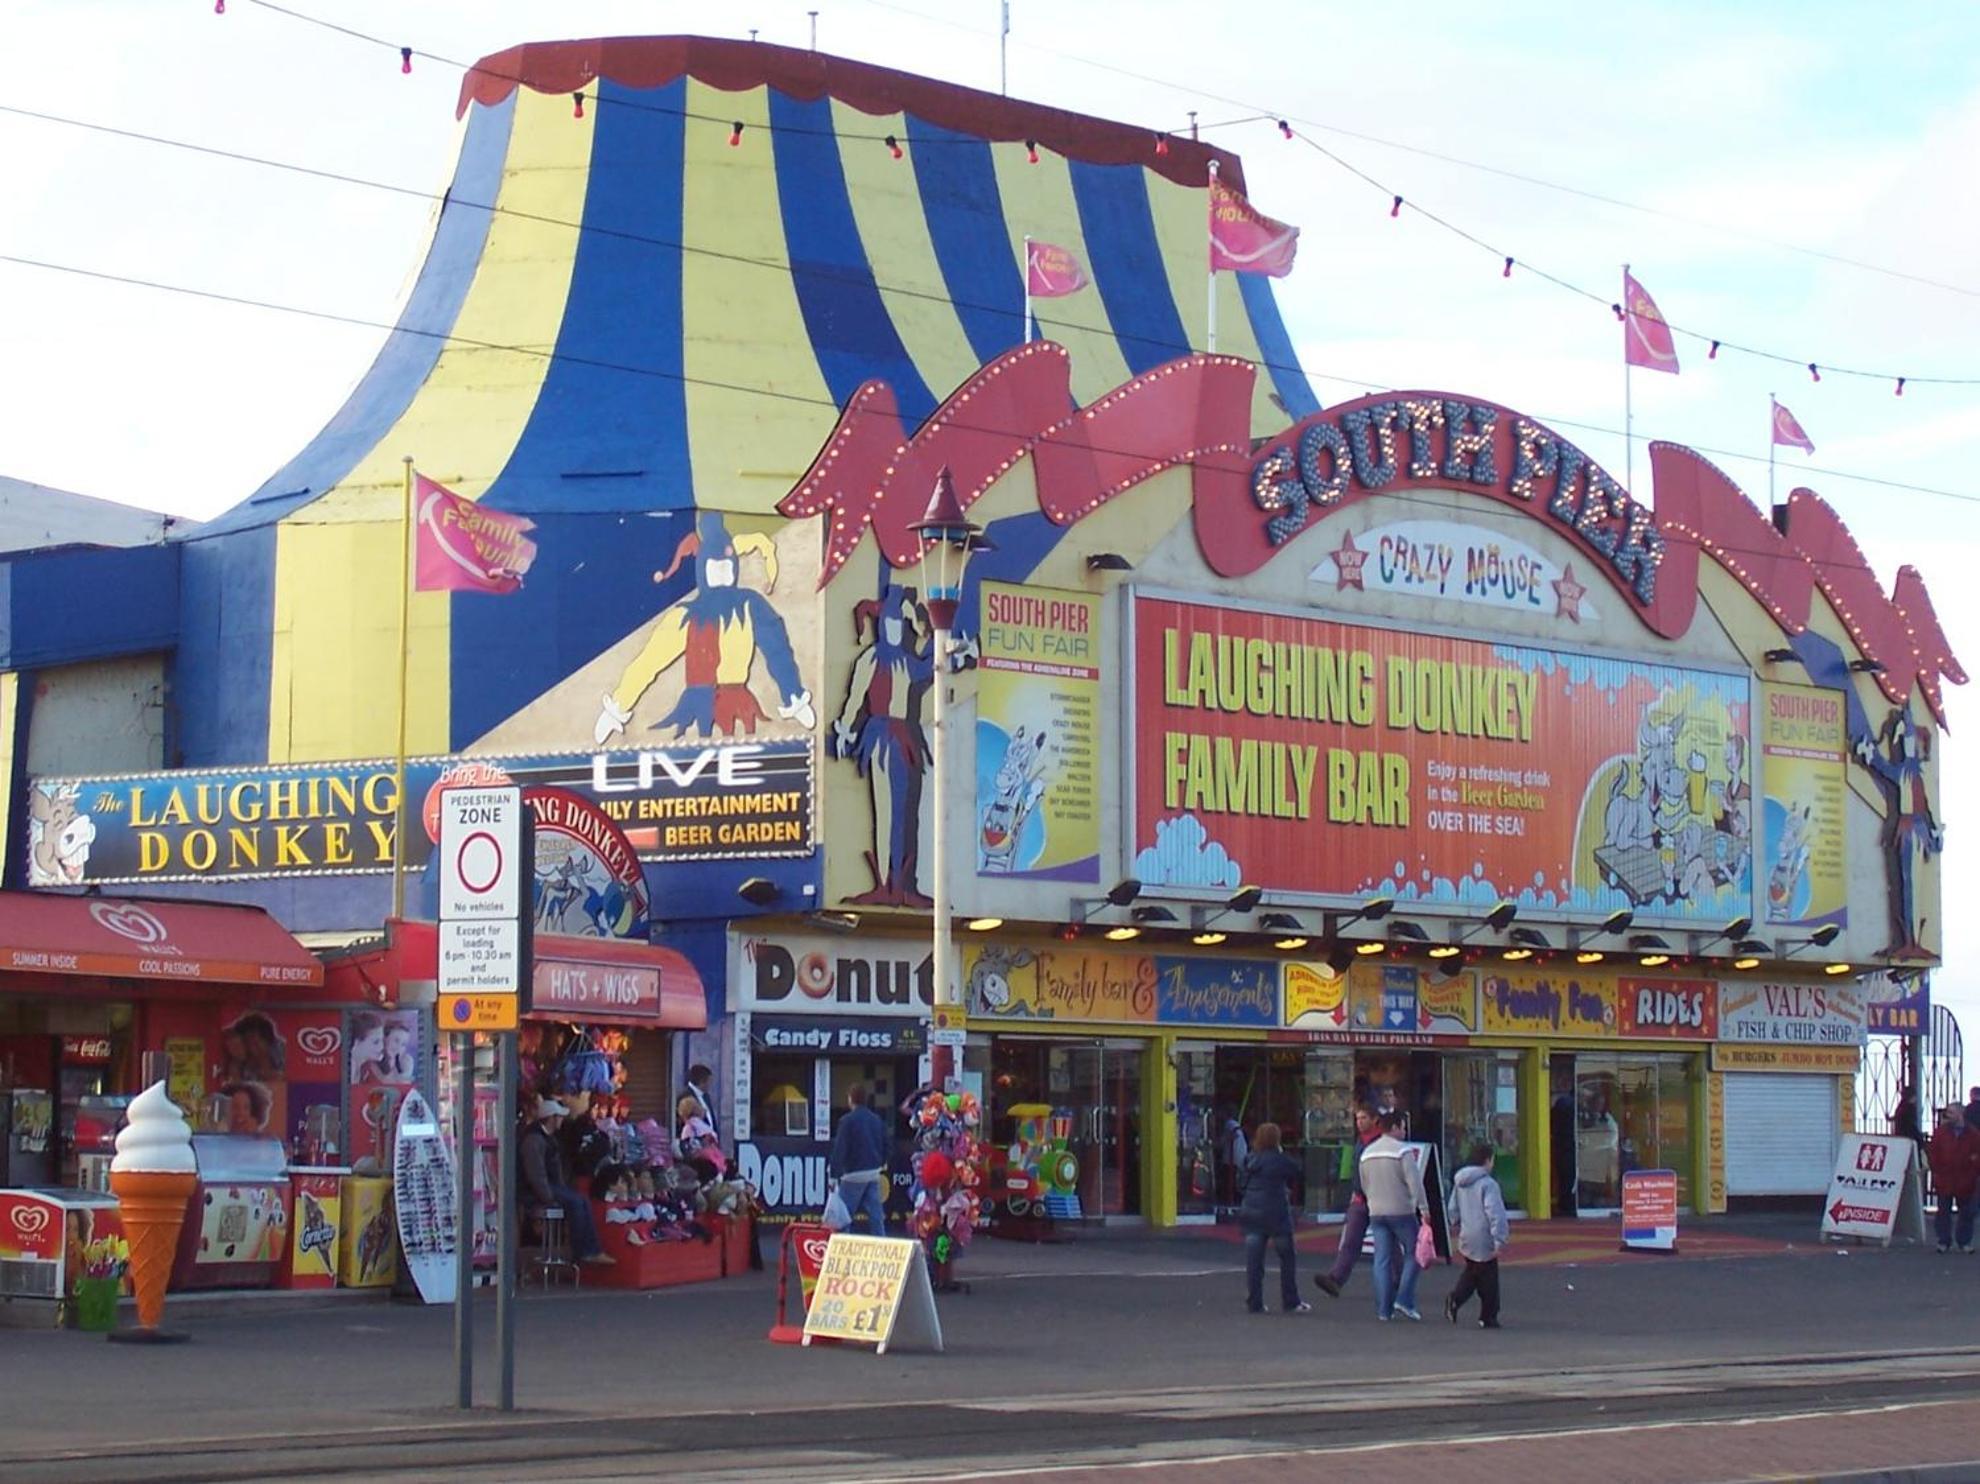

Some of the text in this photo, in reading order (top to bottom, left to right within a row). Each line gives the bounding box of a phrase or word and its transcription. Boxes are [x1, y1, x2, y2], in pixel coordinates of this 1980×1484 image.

[1253, 399, 1665, 607] SOUTH PIER
[1380, 535, 1542, 605] CRAZY MOUSE
[989, 593, 1088, 633] SOUTH PIER
[989, 628, 1089, 657] FUN FAIR
[1165, 628, 1537, 742] LAUGHING DONKEY
[1770, 693, 1838, 724] SOUTH PIER
[1771, 721, 1803, 740] FUN
[441, 764, 506, 786] Bring the
[593, 745, 766, 792] LIVE
[1165, 731, 1410, 827] FAMILY BAR
[1427, 760, 1550, 788] Enjoy a refreshing drink
[93, 792, 123, 813] The
[129, 773, 399, 827] LAUGHING
[451, 795, 511, 806] PEDESTRIAN
[600, 792, 801, 820] ILY ENTERTAINMENT
[1441, 786, 1458, 802] the
[1462, 782, 1494, 807] Beer
[460, 808, 502, 824] ZONE
[1427, 811, 1463, 832] OVER
[1468, 813, 1492, 834] THE
[532, 797, 561, 823] NG
[566, 801, 638, 883] DONKEY
[665, 821, 801, 846] BEER GARDEN
[138, 819, 397, 872] DONKEY
[455, 901, 504, 912] No vehicles
[457, 926, 501, 937] Except for
[463, 939, 494, 949] loading
[13, 952, 78, 969] SUMMER INSIDE
[139, 959, 200, 976] COOL PASSIONS
[453, 952, 466, 962] pm
[499, 952, 512, 960] am
[471, 964, 487, 973] and
[260, 966, 312, 982] PURE ENERGY
[447, 976, 510, 986] permit holders
[1035, 951, 1097, 1016] Family
[551, 969, 588, 1000] HATS
[605, 972, 640, 1005] WIGS
[1164, 964, 1274, 1017] Amusements
[1637, 988, 1704, 1027] RIDES
[1764, 985, 1826, 1019] VAL'S
[1890, 1008, 1918, 1028] BAR
[765, 1029, 832, 1049] Candy
[838, 1029, 892, 1047] Floss
[1737, 1021, 1852, 1042] FISH & CHIP SHOP
[738, 1143, 829, 1207] Donu
[1841, 1207, 1883, 1221] INSIDE
[834, 1241, 906, 1259] TRADITIONAL
[826, 1257, 901, 1280] BLACKPOOL
[824, 1277, 894, 1301] ROCK
[821, 1300, 843, 1313] 20
[810, 1313, 848, 1329] BARS
